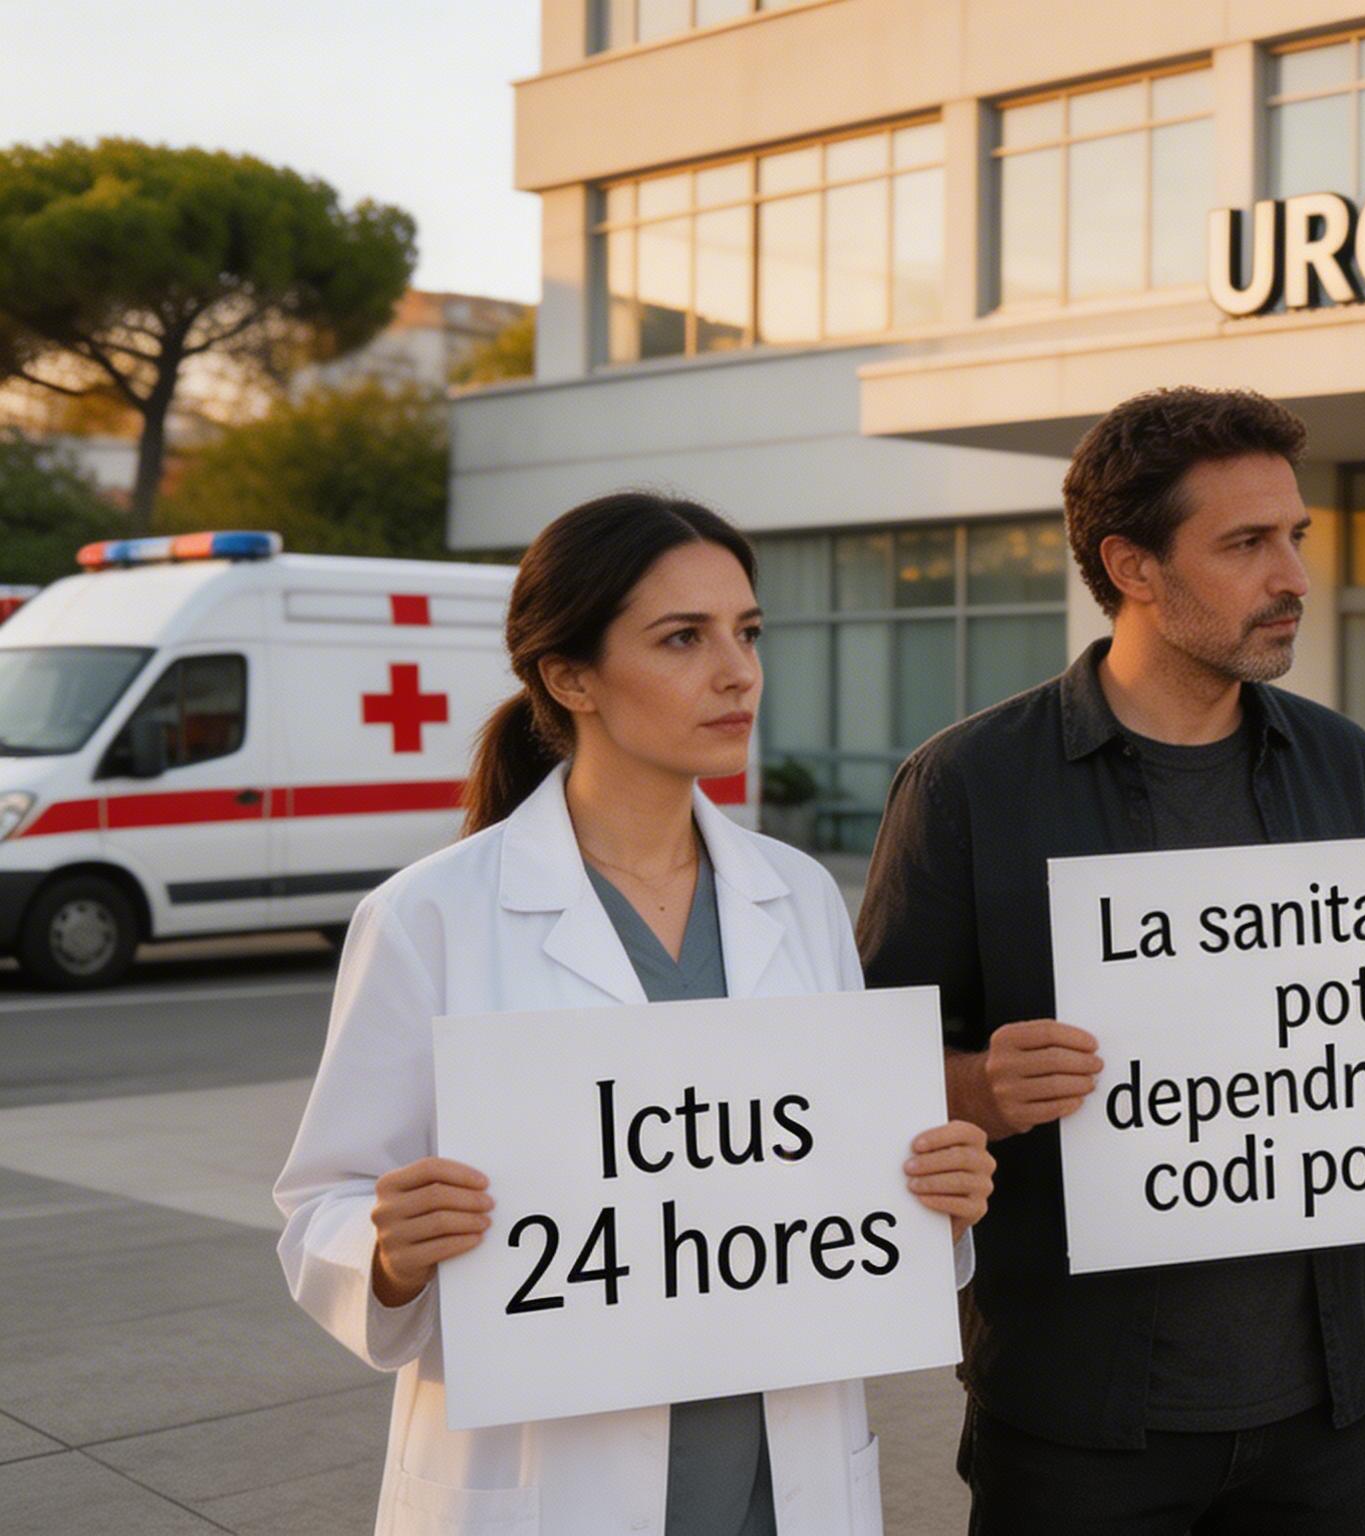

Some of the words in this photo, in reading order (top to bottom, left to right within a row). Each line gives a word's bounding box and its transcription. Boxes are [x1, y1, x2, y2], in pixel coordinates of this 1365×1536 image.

[1099, 896, 1177, 963] La
[595, 1079, 814, 1180] Ictus
[1144, 1133, 1276, 1213] codi
[505, 1206, 630, 1316] 24
[662, 1199, 900, 1299] hores
